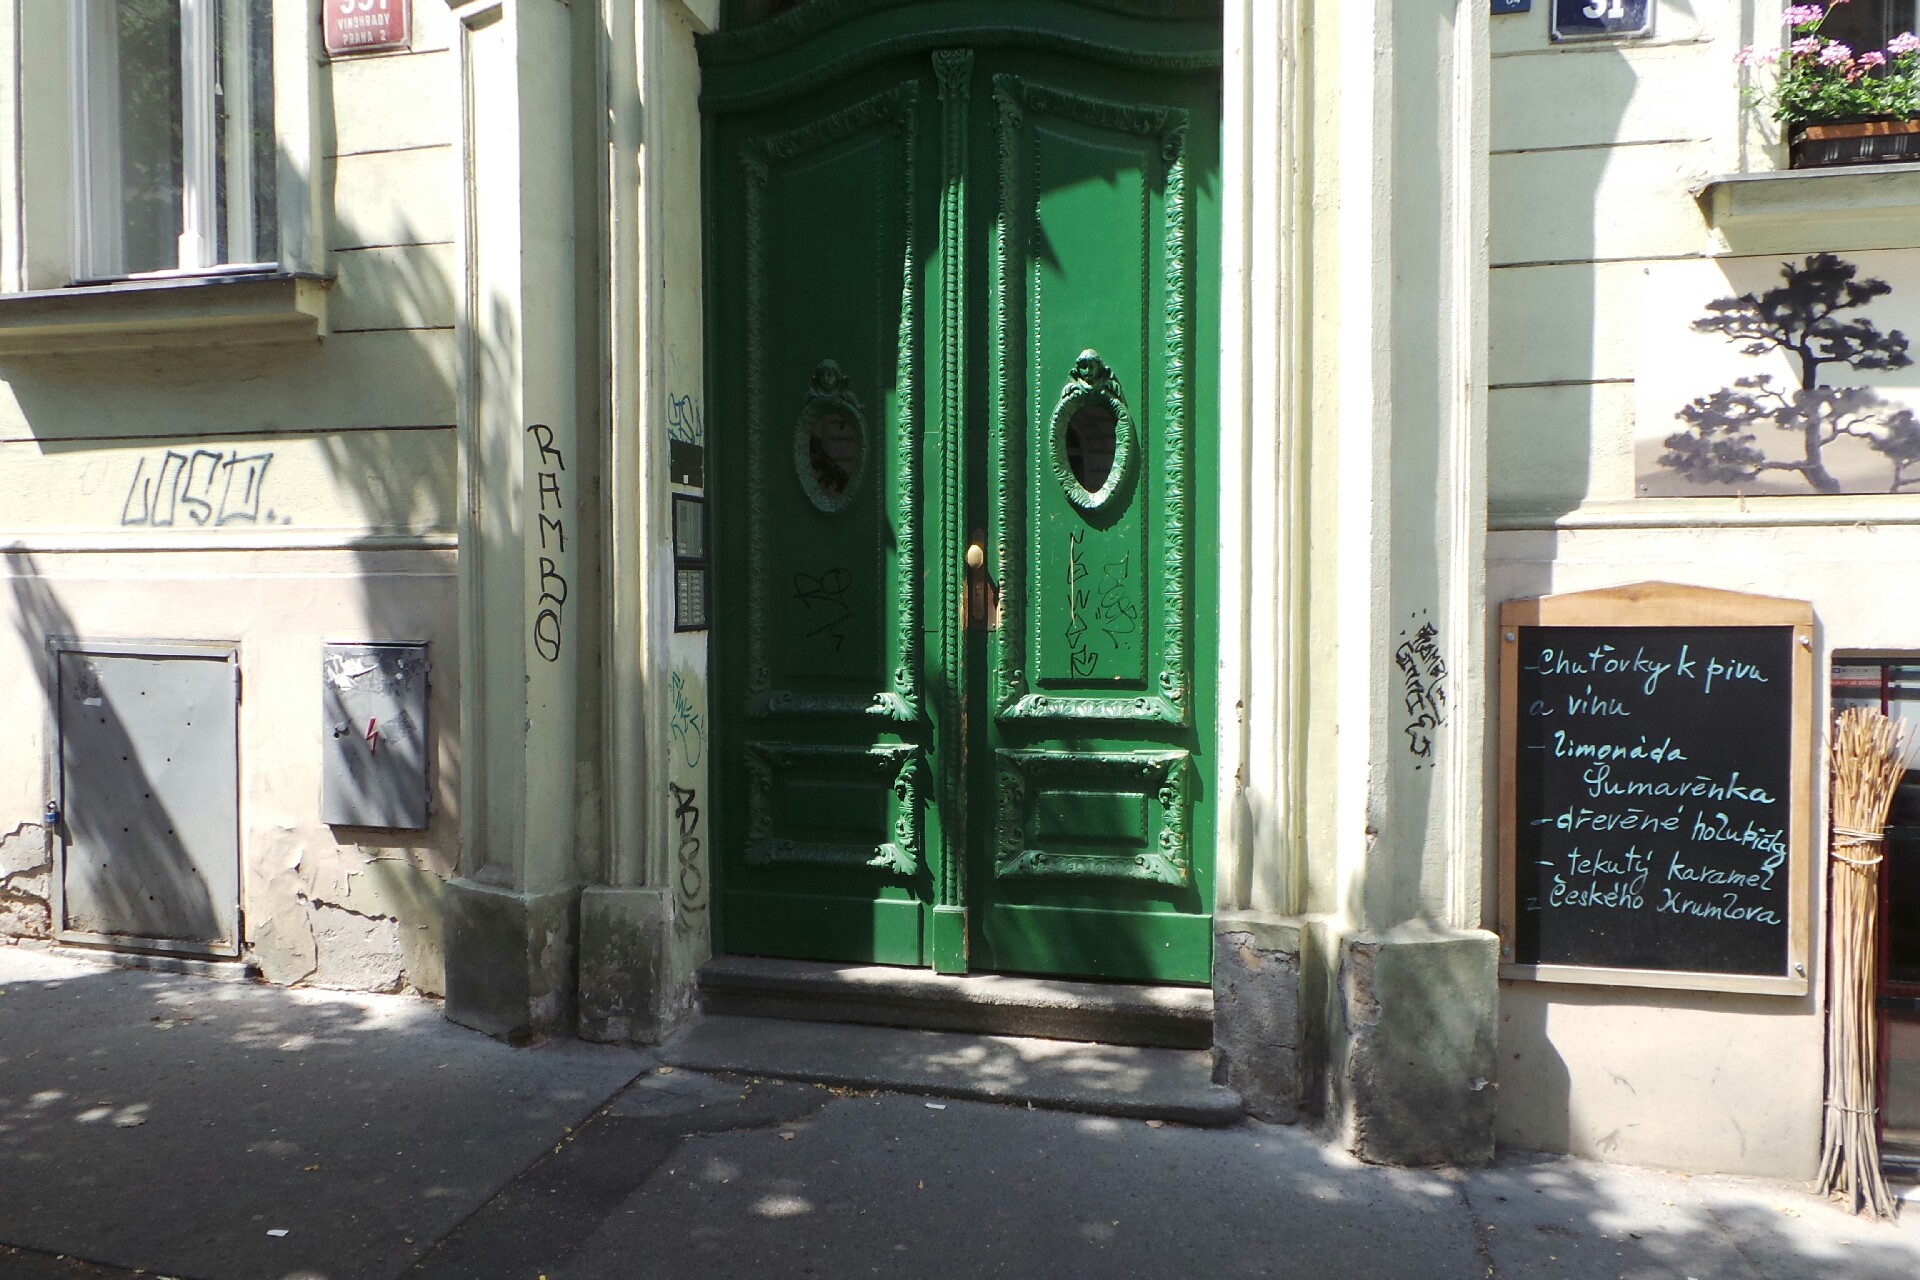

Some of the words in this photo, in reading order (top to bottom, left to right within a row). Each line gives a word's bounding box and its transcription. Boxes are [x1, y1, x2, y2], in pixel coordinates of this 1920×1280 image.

[337, 13, 390, 30] VINOHRADY
[343, 31, 374, 45] PRAHA
[379, 29, 388, 41] 2
[1677, 644, 1696, 679] k
[1705, 656, 1769, 694] pivu
[1529, 699, 1554, 716] a
[1568, 684, 1631, 716] vínu
[1554, 729, 1688, 764] limonáda
[1567, 844, 1653, 895] tekutý
[1667, 850, 1774, 891] karamel
[1549, 873, 1644, 910] Českého
